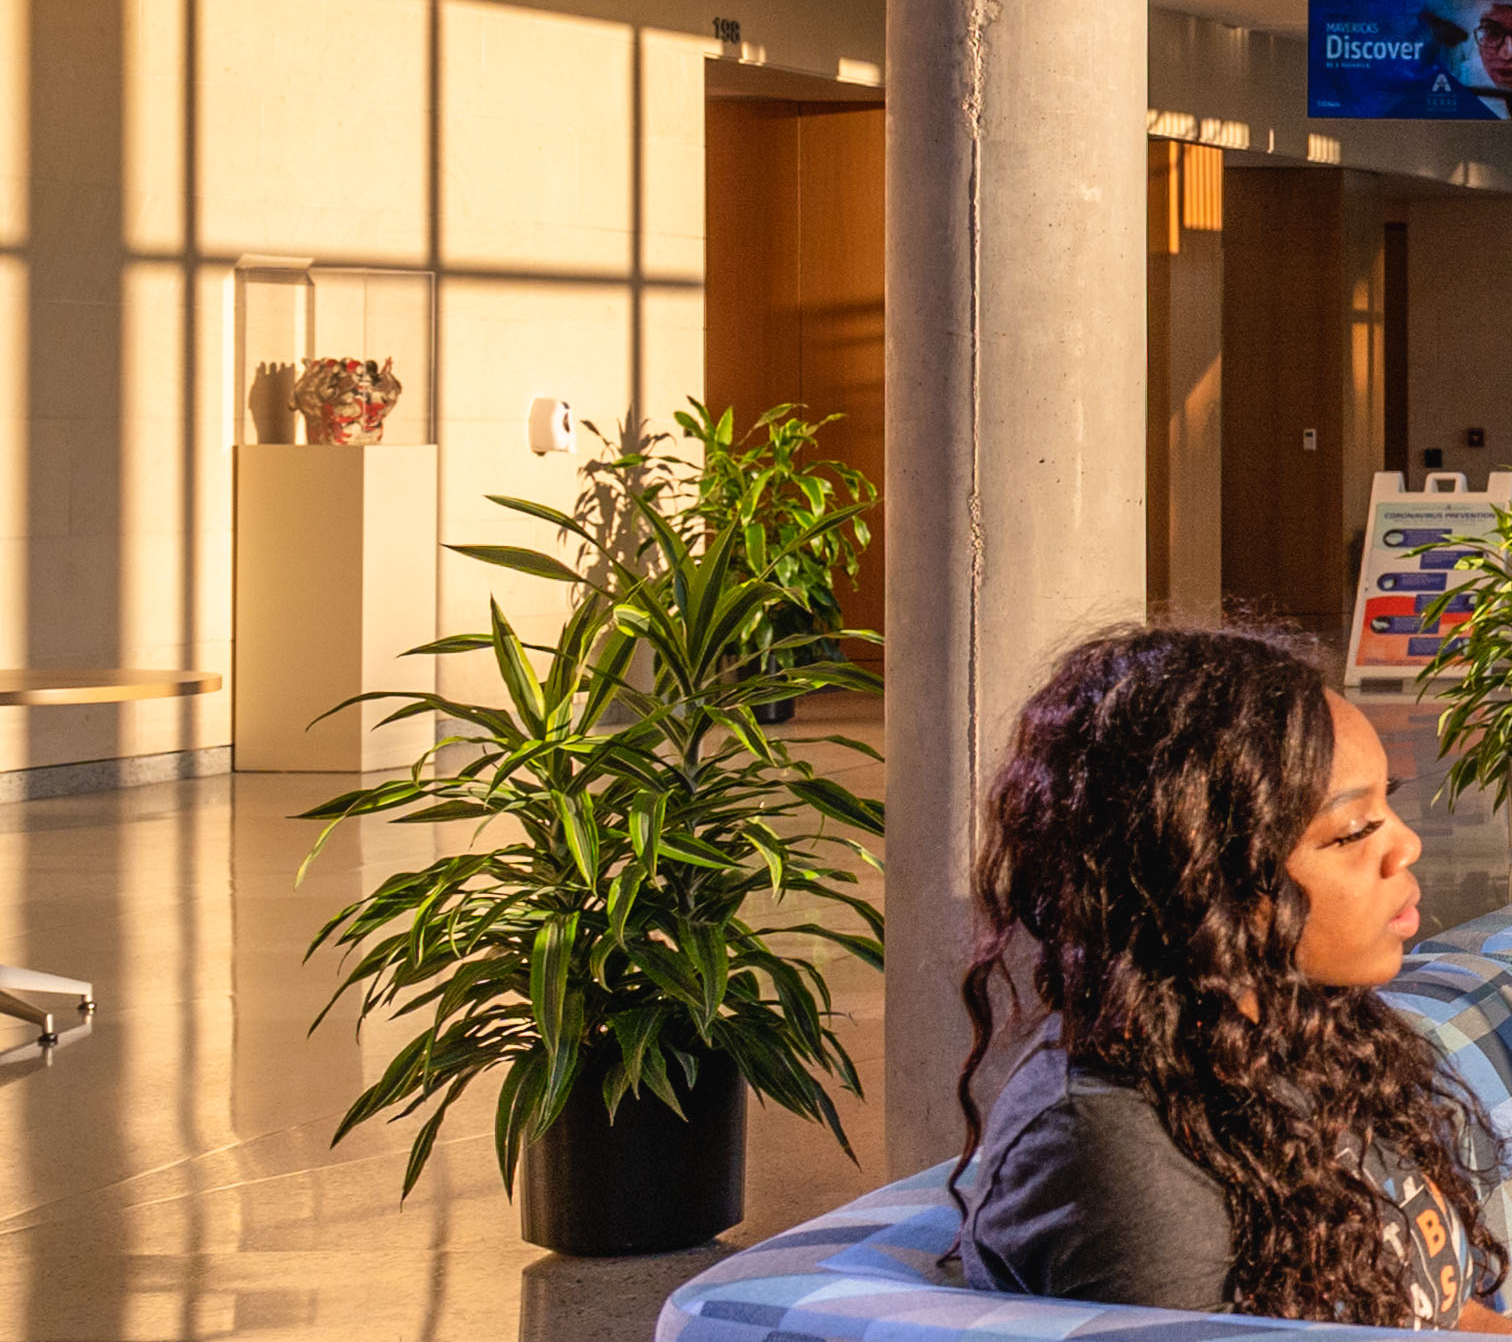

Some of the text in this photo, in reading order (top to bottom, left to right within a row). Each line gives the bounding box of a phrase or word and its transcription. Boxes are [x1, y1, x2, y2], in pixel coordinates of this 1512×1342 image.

[1326, 34, 1424, 59] Discover
[1384, 512, 1496, 520] CORONAVIRUS PREVENTION
